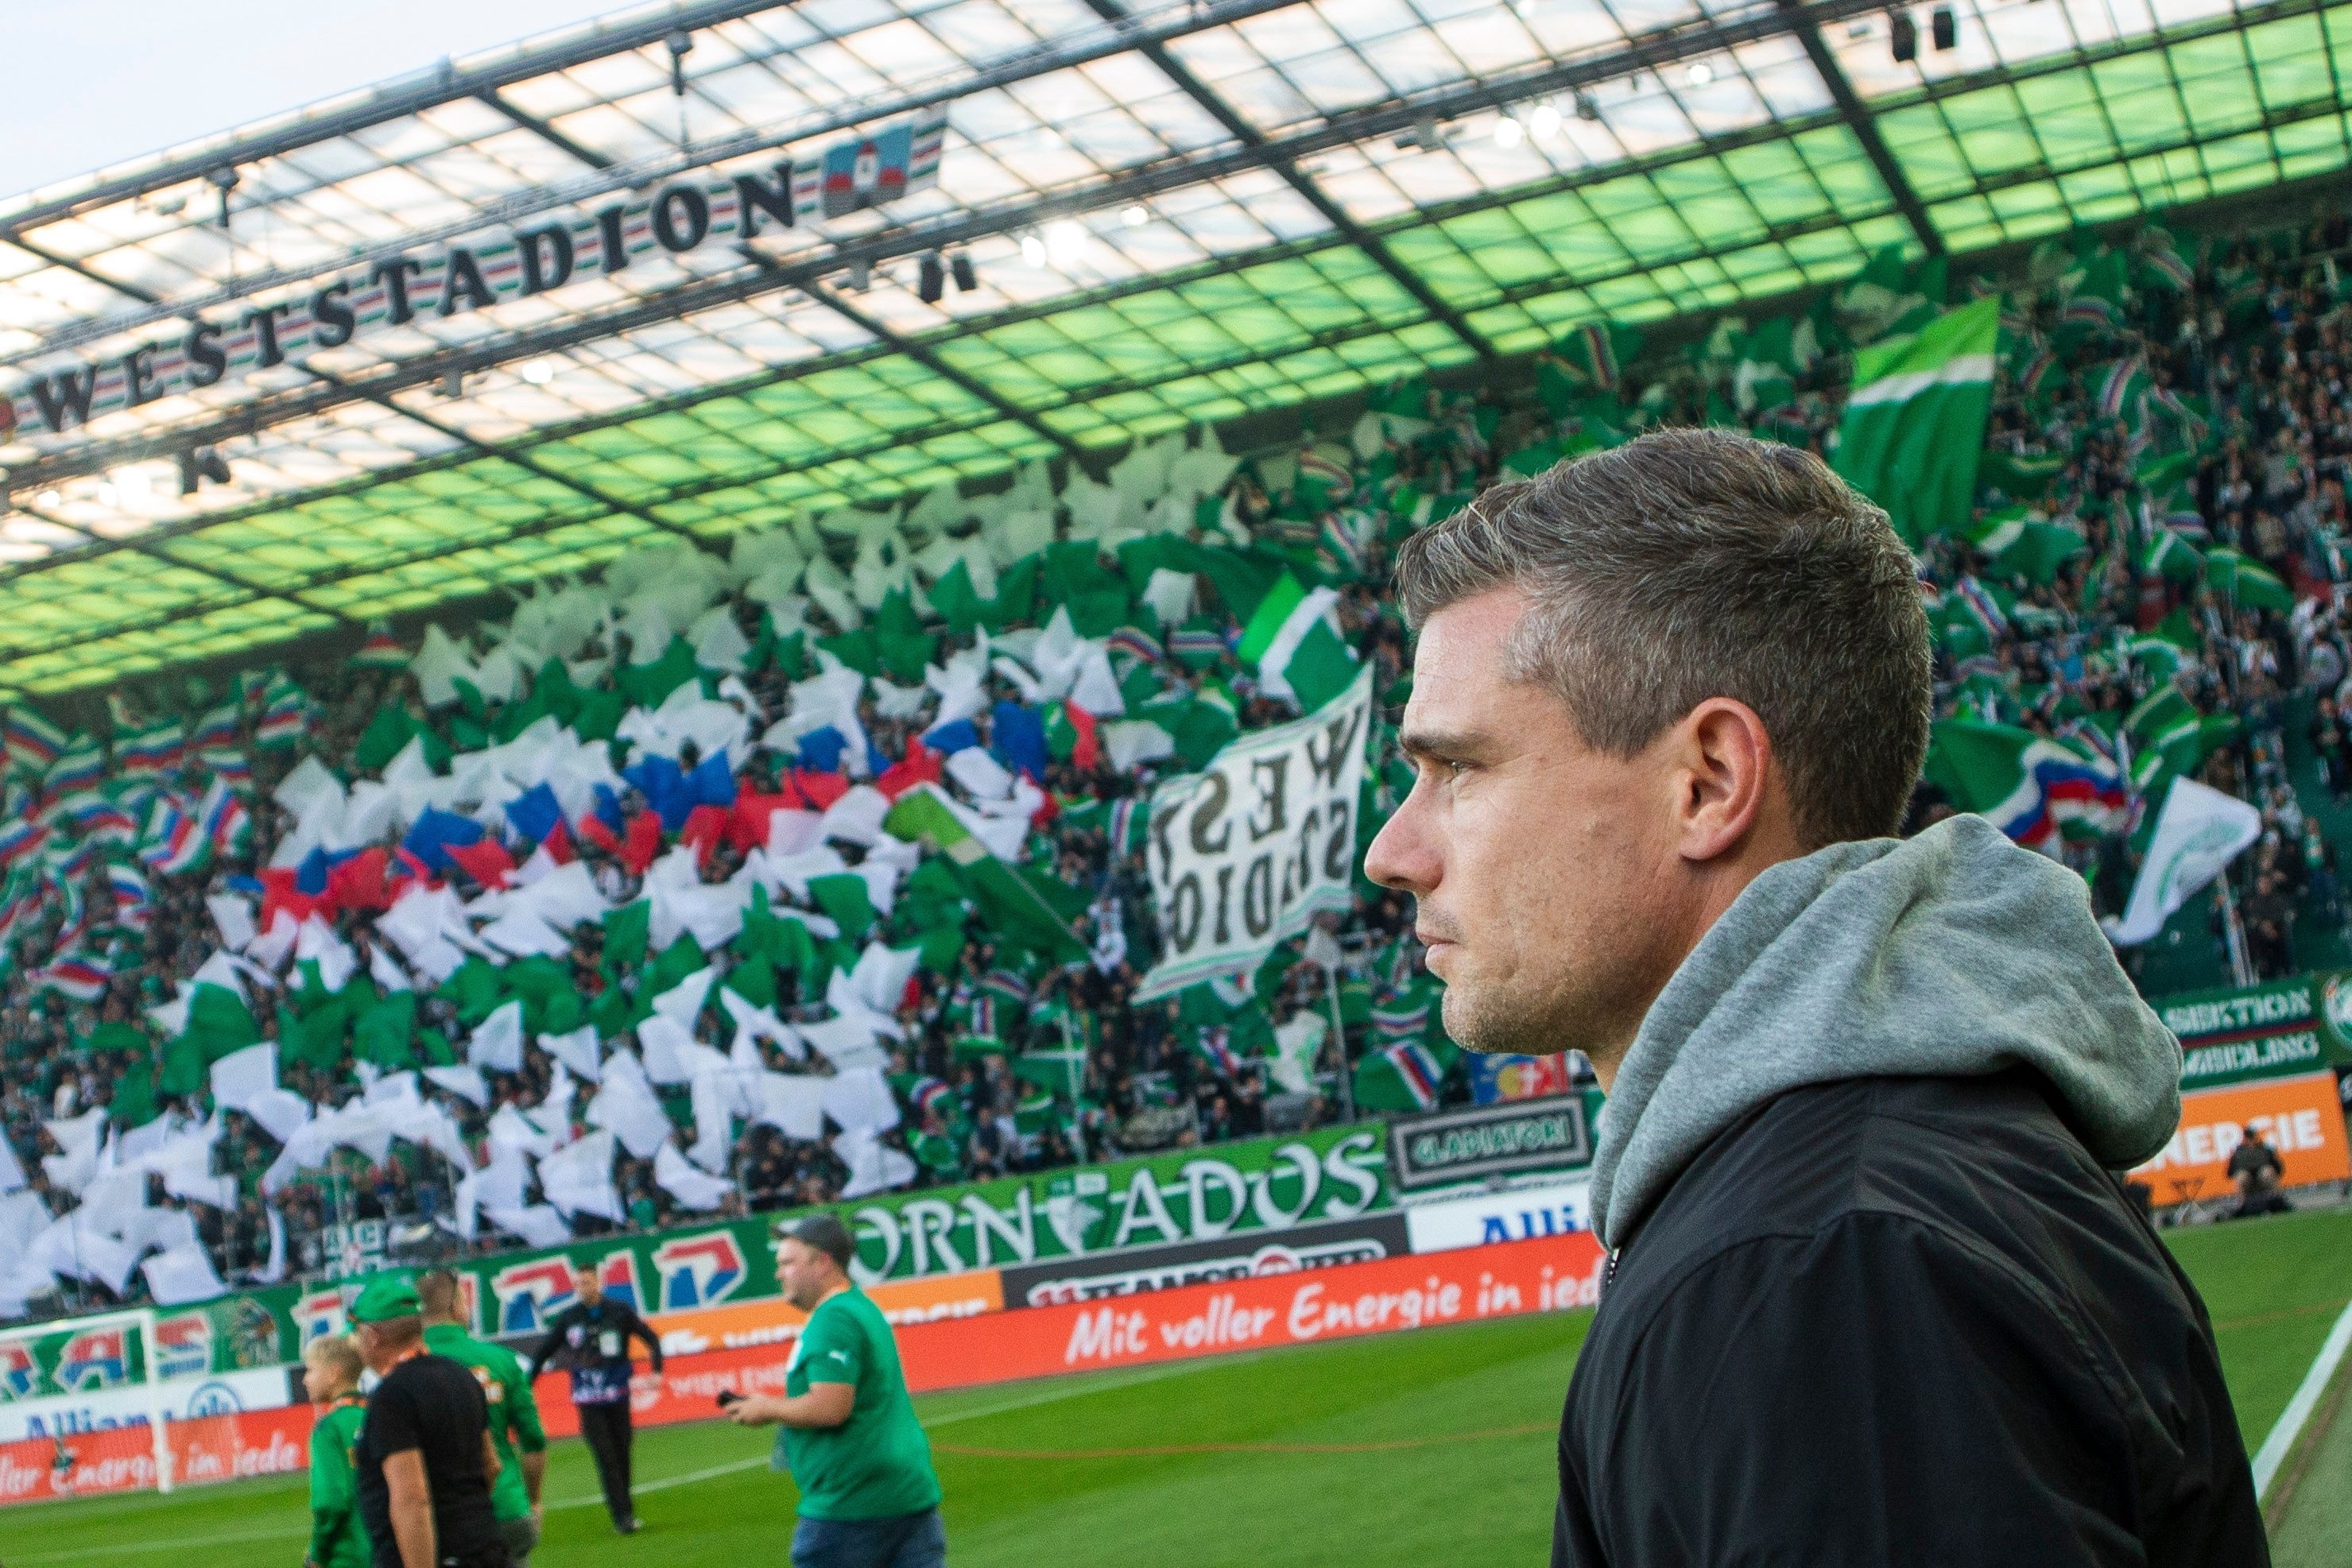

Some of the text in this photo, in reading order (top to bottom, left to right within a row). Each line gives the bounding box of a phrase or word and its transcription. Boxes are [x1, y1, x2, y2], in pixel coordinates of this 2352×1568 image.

[29, 159, 797, 432] WESTSTADION
[1065, 1255, 1606, 1364] Mit voller Energie in jed
[27, 1408, 174, 1439] Allian
